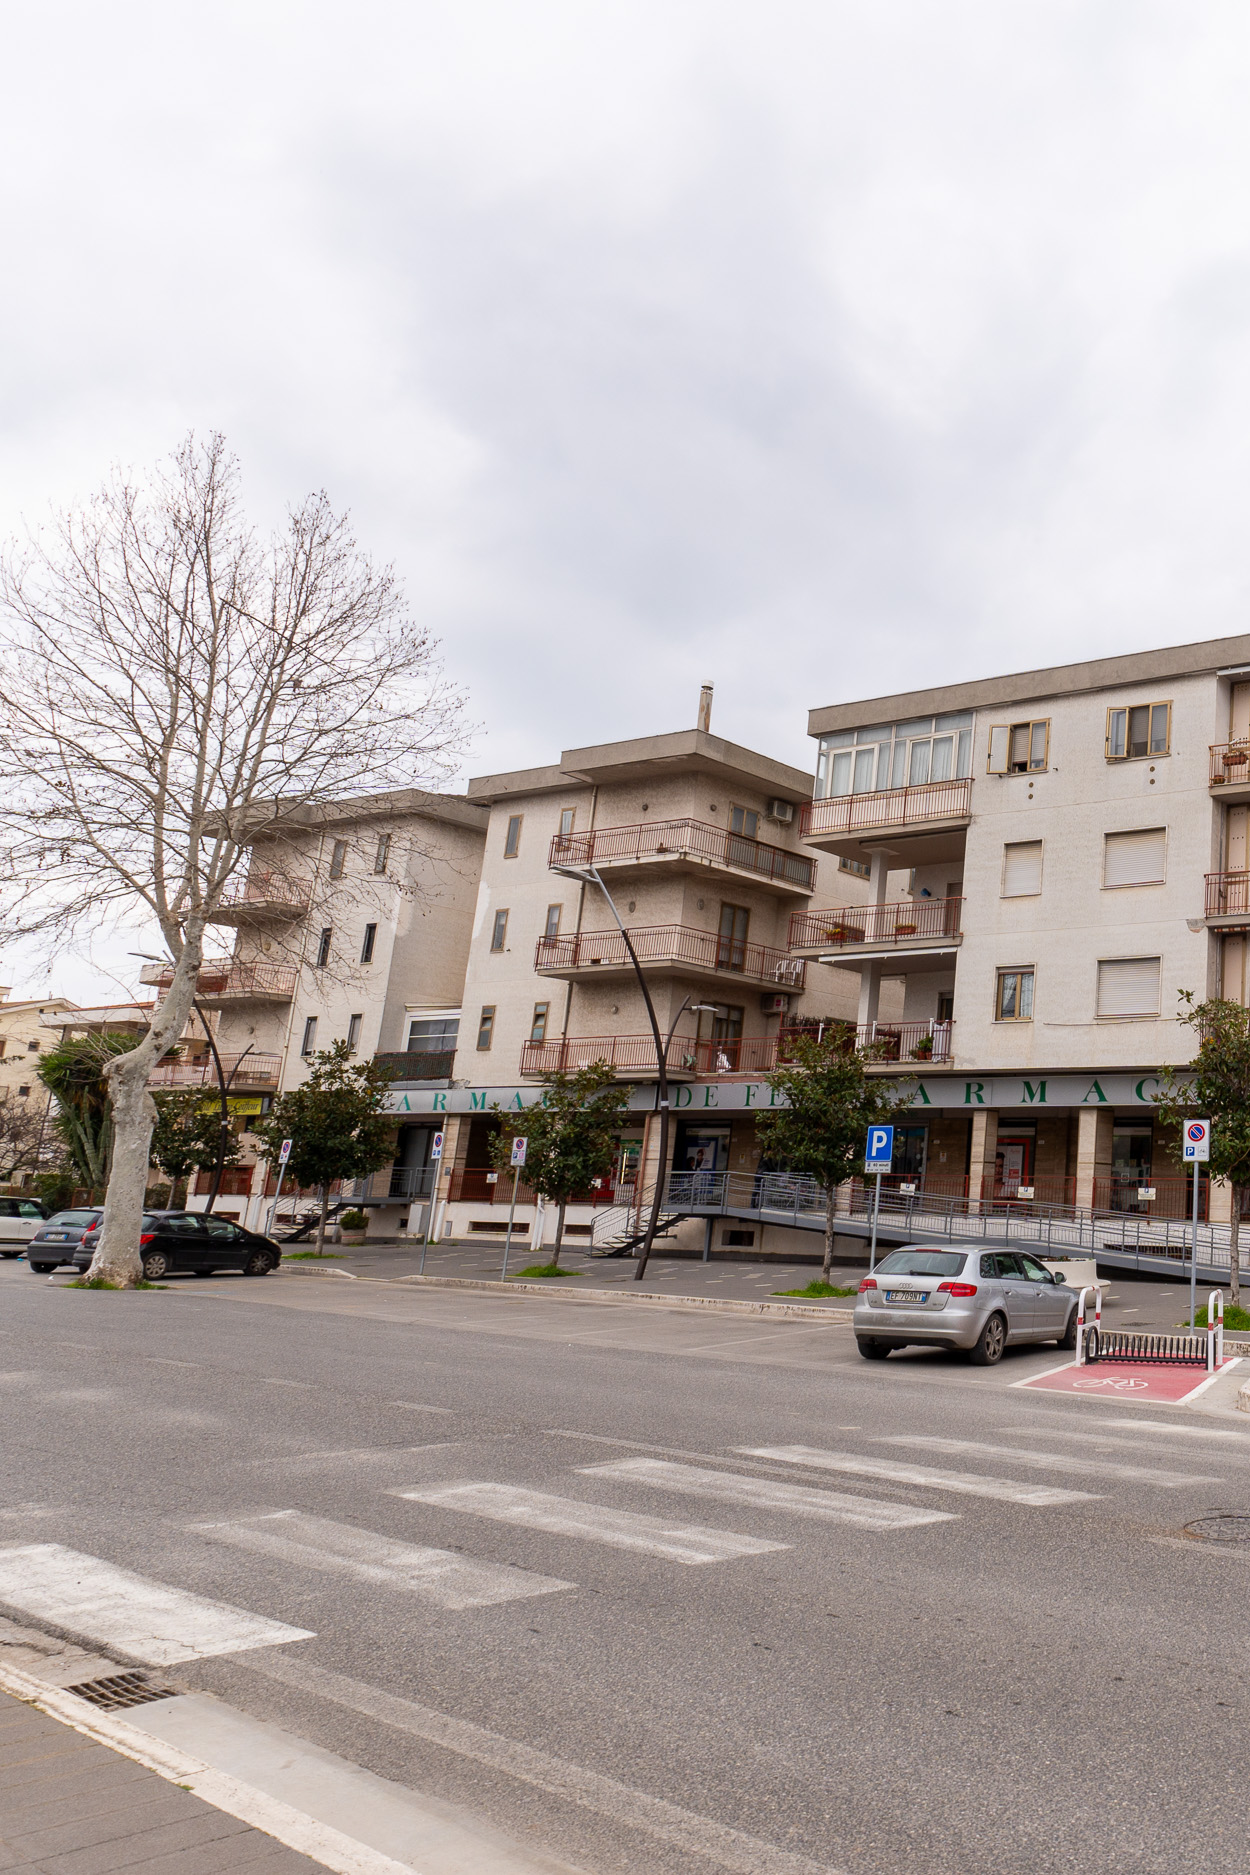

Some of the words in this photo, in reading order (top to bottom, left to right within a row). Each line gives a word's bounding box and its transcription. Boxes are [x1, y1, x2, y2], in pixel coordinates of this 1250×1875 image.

[674, 1085, 719, 1108] DE
[871, 1131, 888, 1157] P
[1187, 1148, 1194, 1156] P
